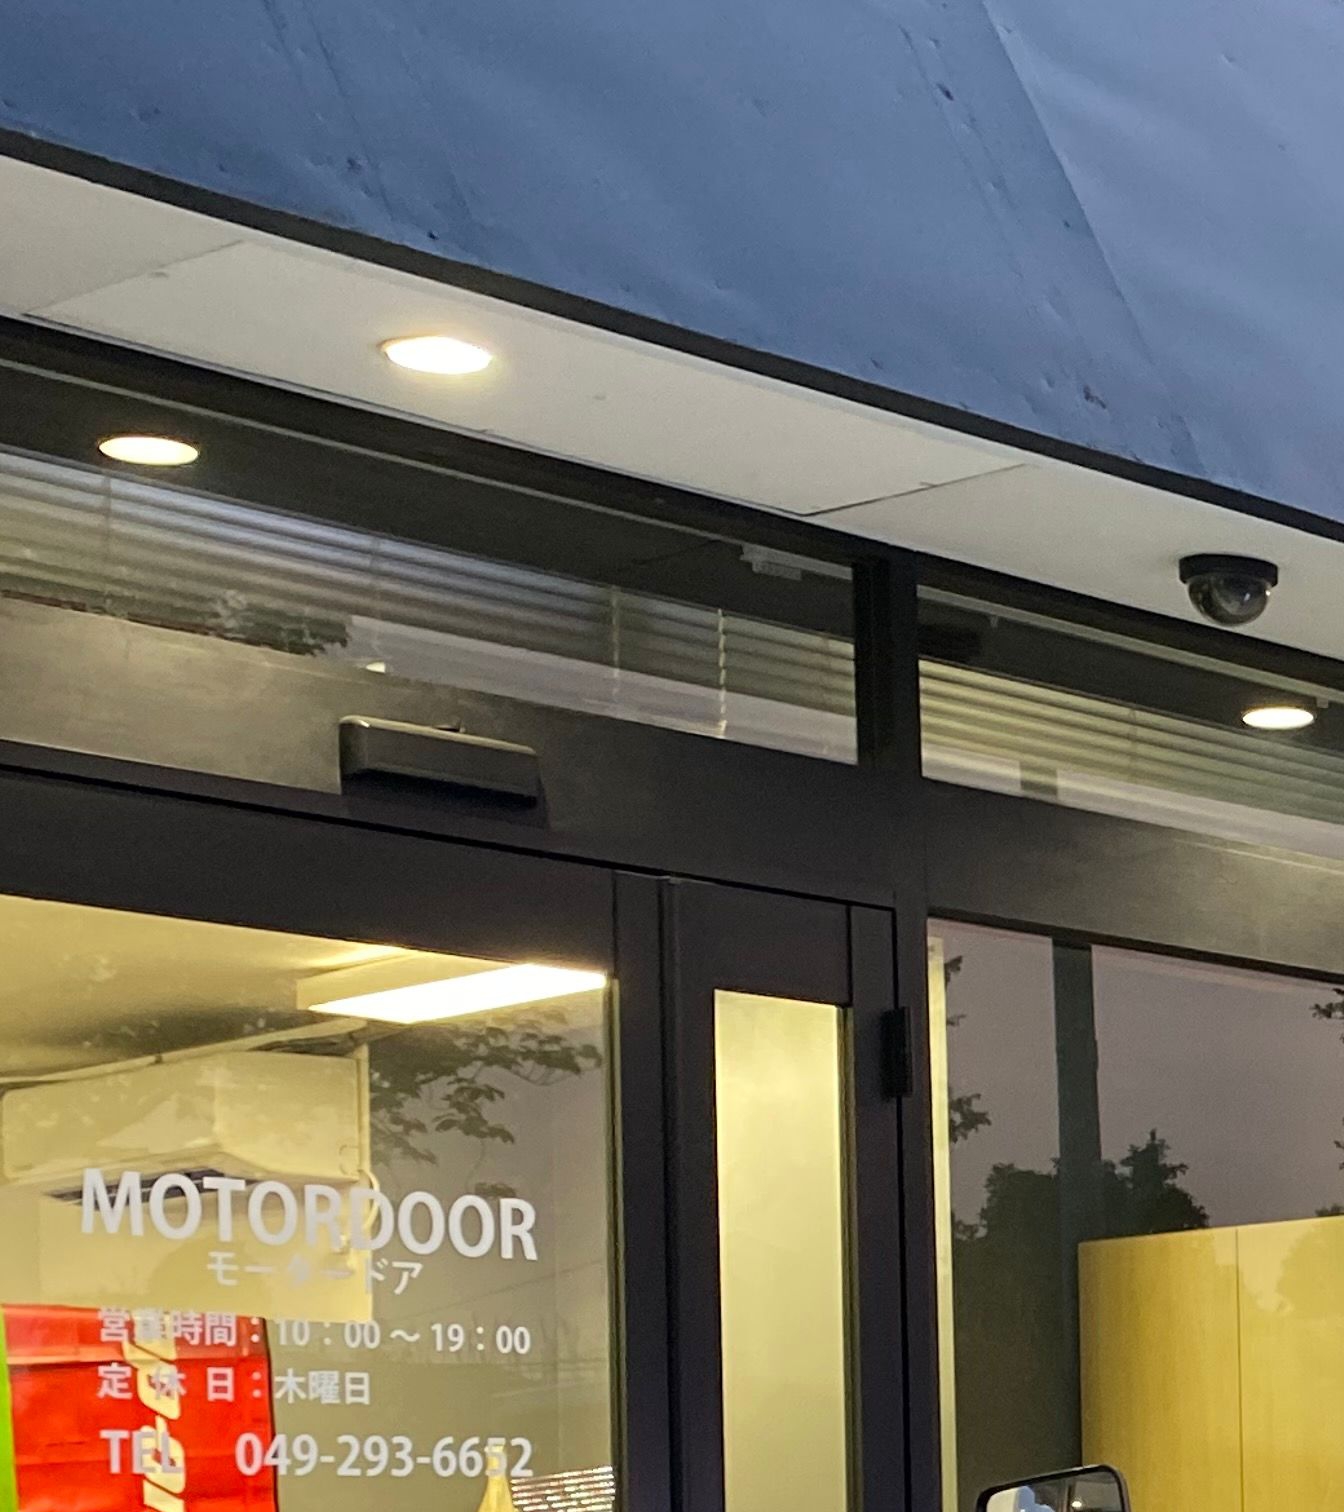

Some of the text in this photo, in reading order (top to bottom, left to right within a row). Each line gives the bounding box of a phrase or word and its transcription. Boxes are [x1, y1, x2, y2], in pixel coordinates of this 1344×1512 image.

[80, 1166, 539, 1261] MOTORDOOR
[99, 1429, 534, 1478] TEL 049-293-6652
